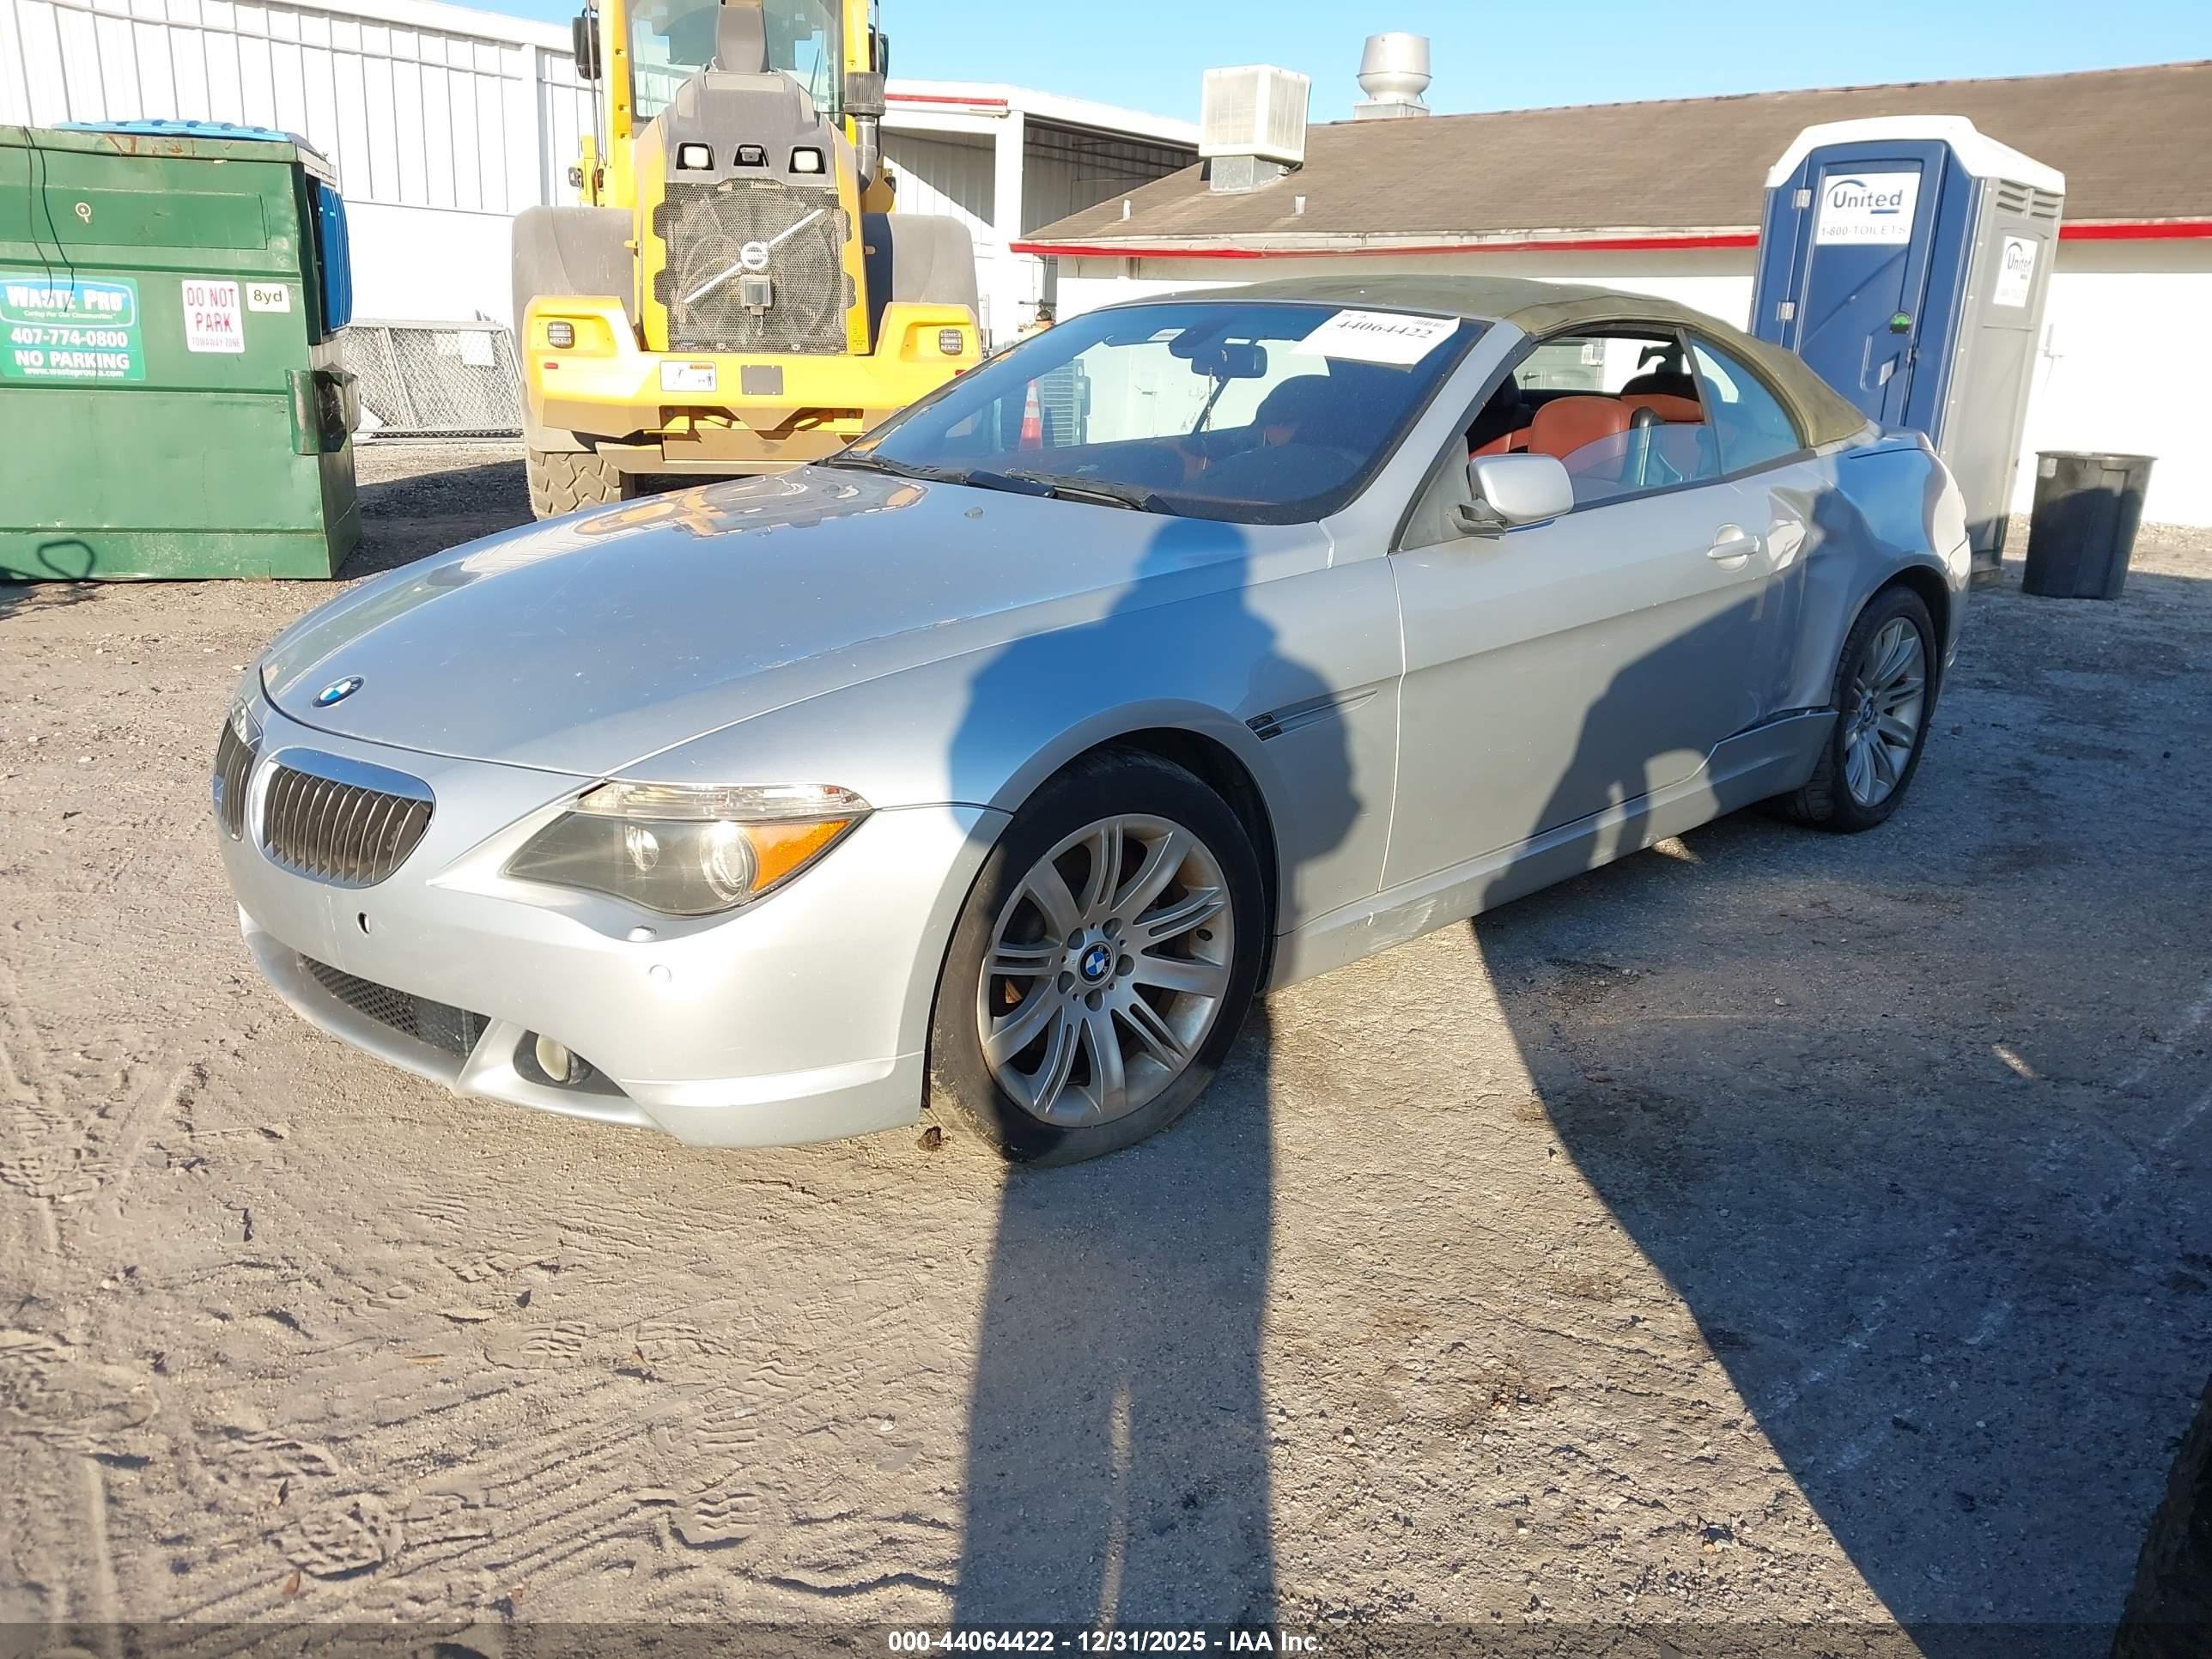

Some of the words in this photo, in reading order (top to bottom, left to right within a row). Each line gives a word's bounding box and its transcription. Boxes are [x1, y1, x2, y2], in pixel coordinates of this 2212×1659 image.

[1833, 189, 1904, 208] United
[1821, 225, 1906, 236] 1-800-TOILETS
[5, 285, 76, 309] WASTE
[83, 289, 123, 311] PRO
[187, 288, 204, 307] DO
[210, 288, 235, 307] NOT
[254, 289, 283, 305] 8yd
[195, 313, 233, 332] PARK
[1336, 320, 1433, 337] 44064422
[11, 327, 128, 348] 407-774-0800
[15, 349, 44, 367] NO
[50, 350, 131, 370] PARKING
